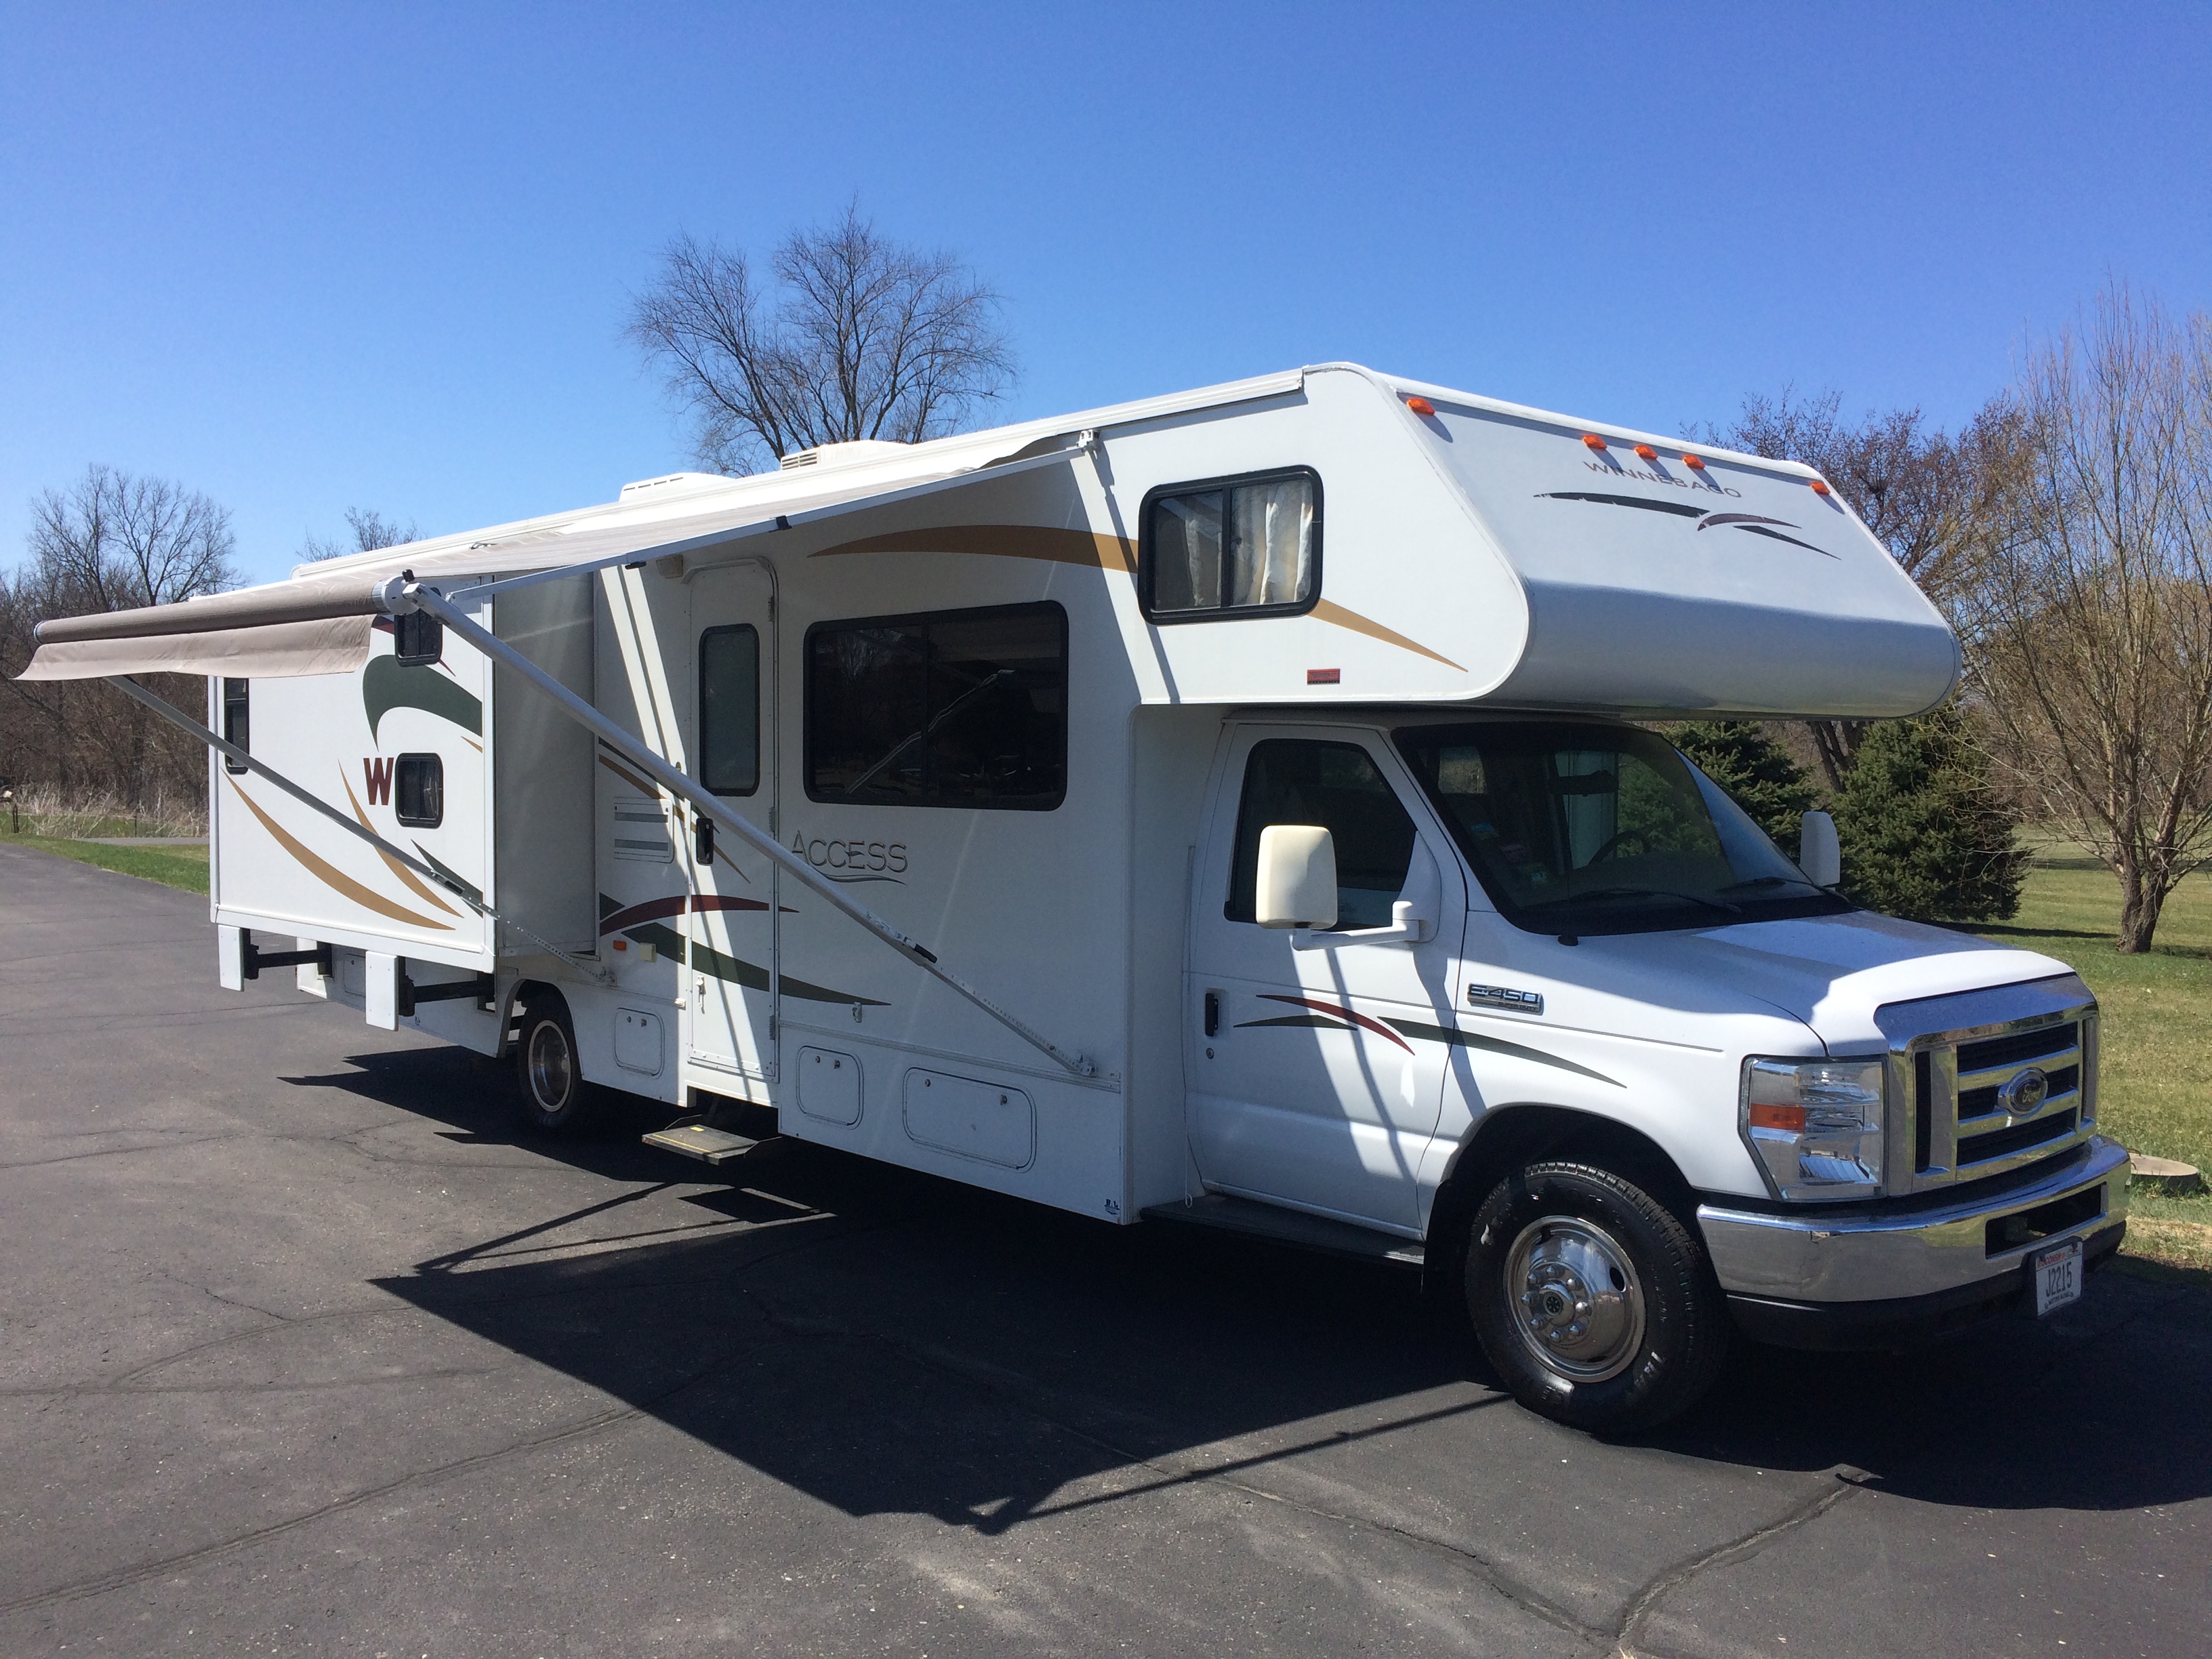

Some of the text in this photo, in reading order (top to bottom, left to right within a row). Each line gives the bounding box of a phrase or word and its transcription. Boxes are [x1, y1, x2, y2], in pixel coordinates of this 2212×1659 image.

[1582, 460, 1742, 498] WINNEBAGO
[363, 757, 394, 806] W
[791, 830, 908, 873] ACCESS
[2045, 1261, 2072, 1297] J2215
